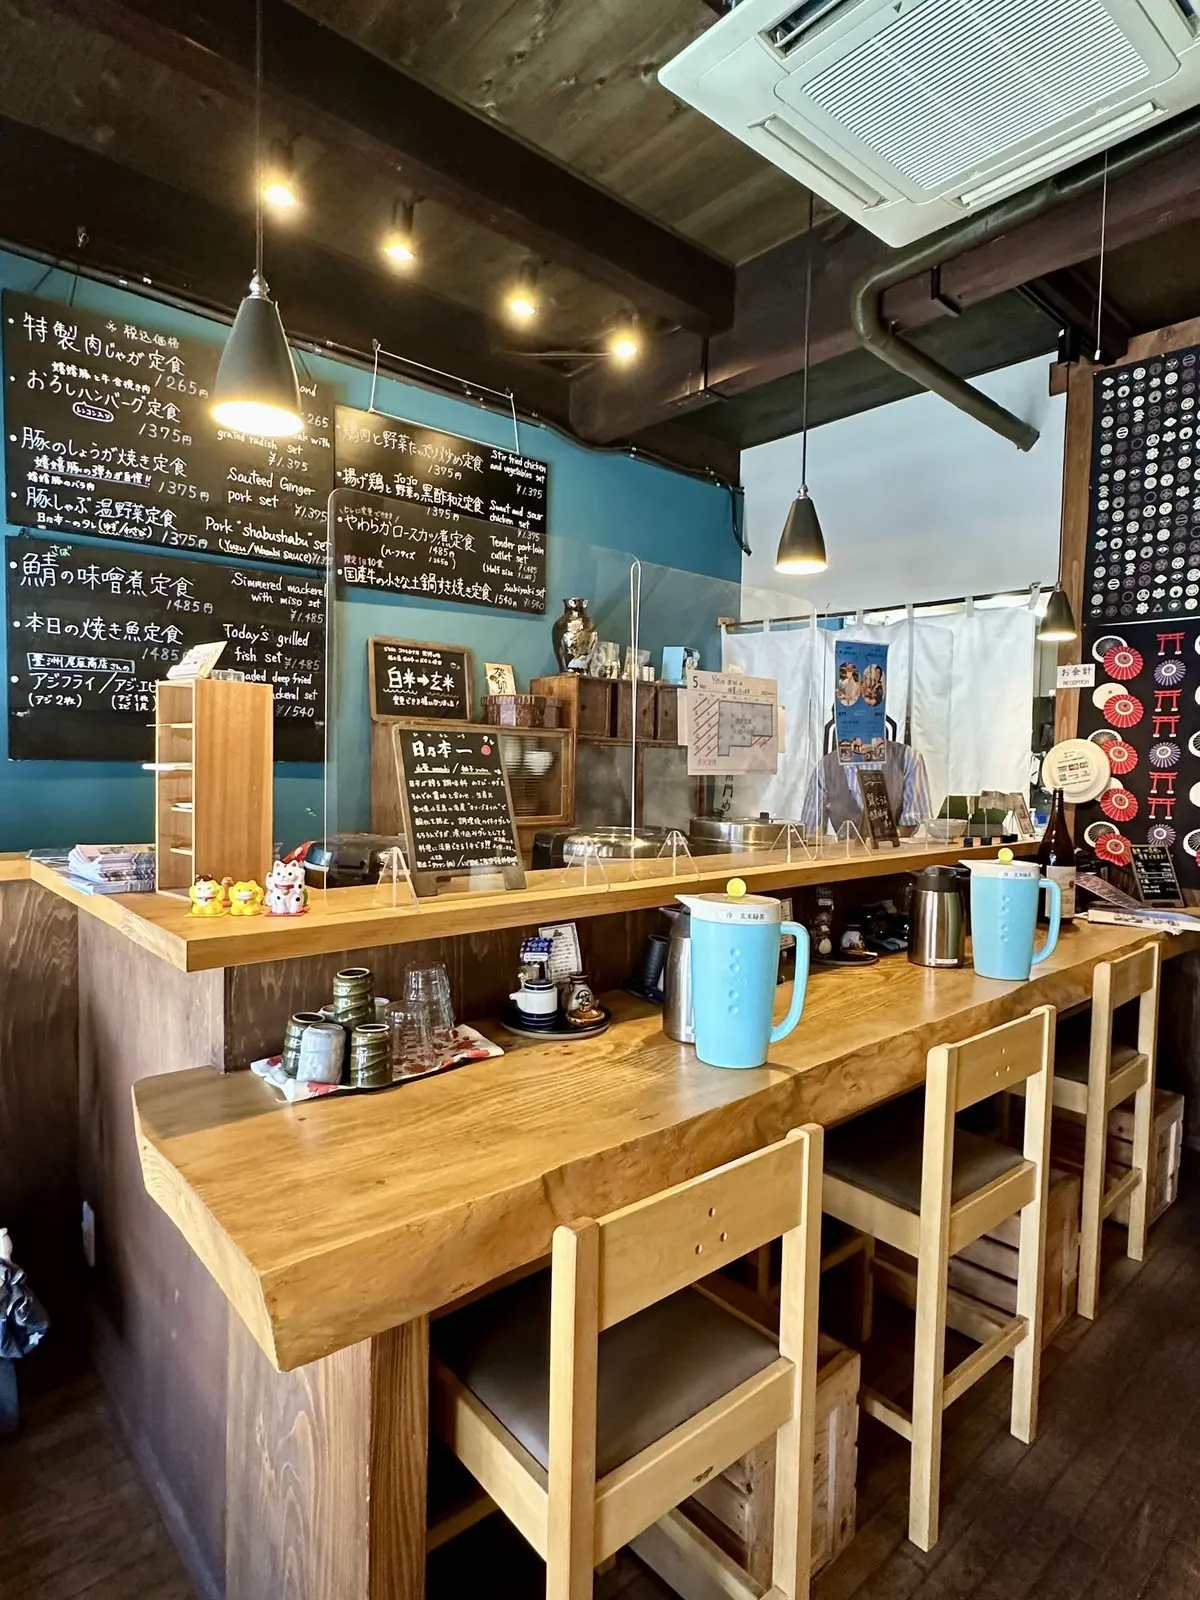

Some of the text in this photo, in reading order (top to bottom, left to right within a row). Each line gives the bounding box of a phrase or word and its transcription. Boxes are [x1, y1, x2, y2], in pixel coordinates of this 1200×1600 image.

[22, 312, 187, 377] 特製肉じゃが定食
[27, 369, 181, 423] おろしハンバーグ定食
[154, 373, 210, 400] 1265円
[138, 422, 193, 447] 1375円
[216, 429, 304, 456] grated radish set
[311, 436, 331, 449] with
[21, 426, 188, 478] 豚のしょうが焼き定食
[227, 467, 316, 497] Sauteed Ginger
[393, 472, 419, 487] ゴロゴロ
[158, 481, 211, 503] 1375円
[259, 494, 280, 509] set
[26, 486, 178, 531] 豚しゃぶ温野菜定食
[526, 510, 544, 521] sour
[205, 516, 235, 535] Pork
[344, 513, 477, 553] やわらかロースカツ煮定食
[518, 520, 531, 530] set
[161, 530, 209, 550] 1375円
[489, 535, 516, 550] Tender
[50, 544, 73, 557] さば
[490, 550, 530, 565] cutlet set
[20, 551, 196, 601] 鯖の味噌煮定食
[231, 572, 328, 598] Simmered mackerel
[344, 565, 493, 605] 国産牛の小さな土鍋すき焼き定食
[503, 583, 535, 596] Sukiyaki
[166, 599, 215, 615] 1485円
[251, 592, 322, 609] with miso set
[25, 611, 185, 646] 本日の焼き魚定食
[222, 623, 311, 648] Today's grilled
[142, 647, 185, 661] 1485
[234, 646, 258, 663] fish
[264, 651, 284, 664] set
[245, 669, 313, 687] aded deep fried
[387, 666, 456, 693] 白米 玄米
[1062, 666, 1092, 677] お会計
[304, 688, 319, 700] set
[411, 740, 473, 759] 日乃本一
